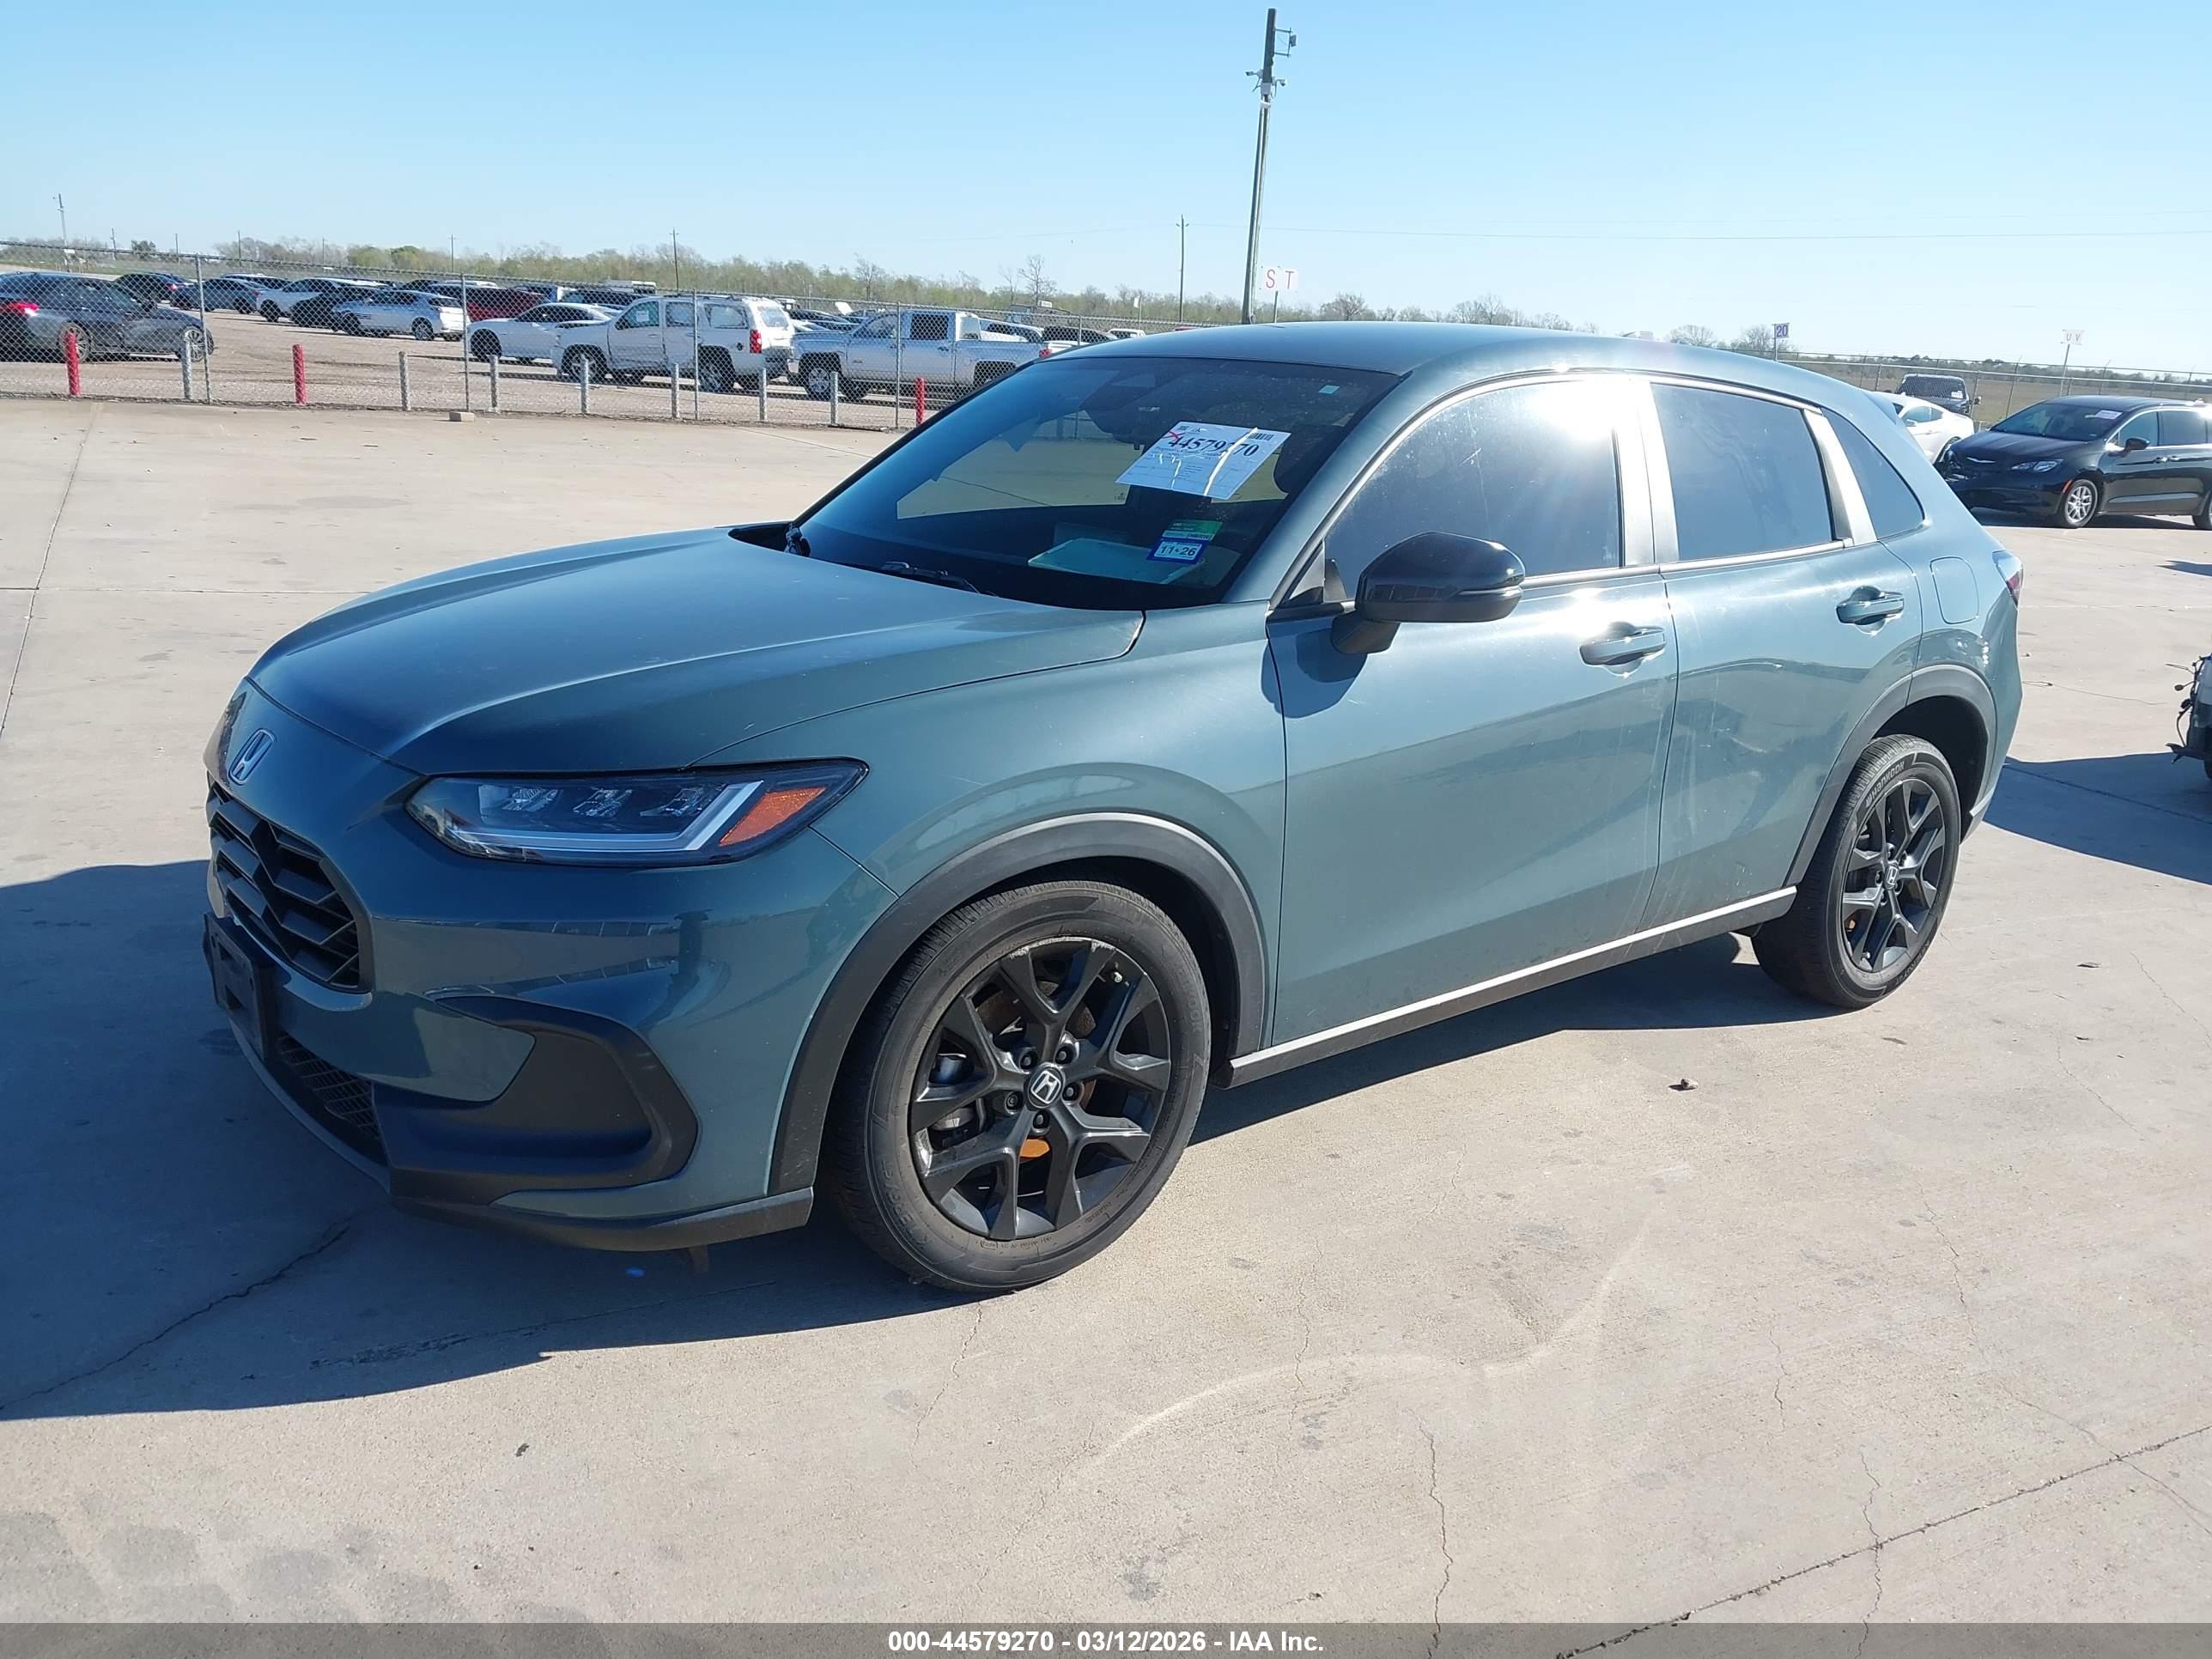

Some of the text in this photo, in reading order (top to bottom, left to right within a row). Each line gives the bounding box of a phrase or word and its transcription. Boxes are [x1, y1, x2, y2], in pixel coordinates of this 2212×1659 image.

[1266, 268, 1295, 289] S T
[1776, 324, 1788, 337] 20
